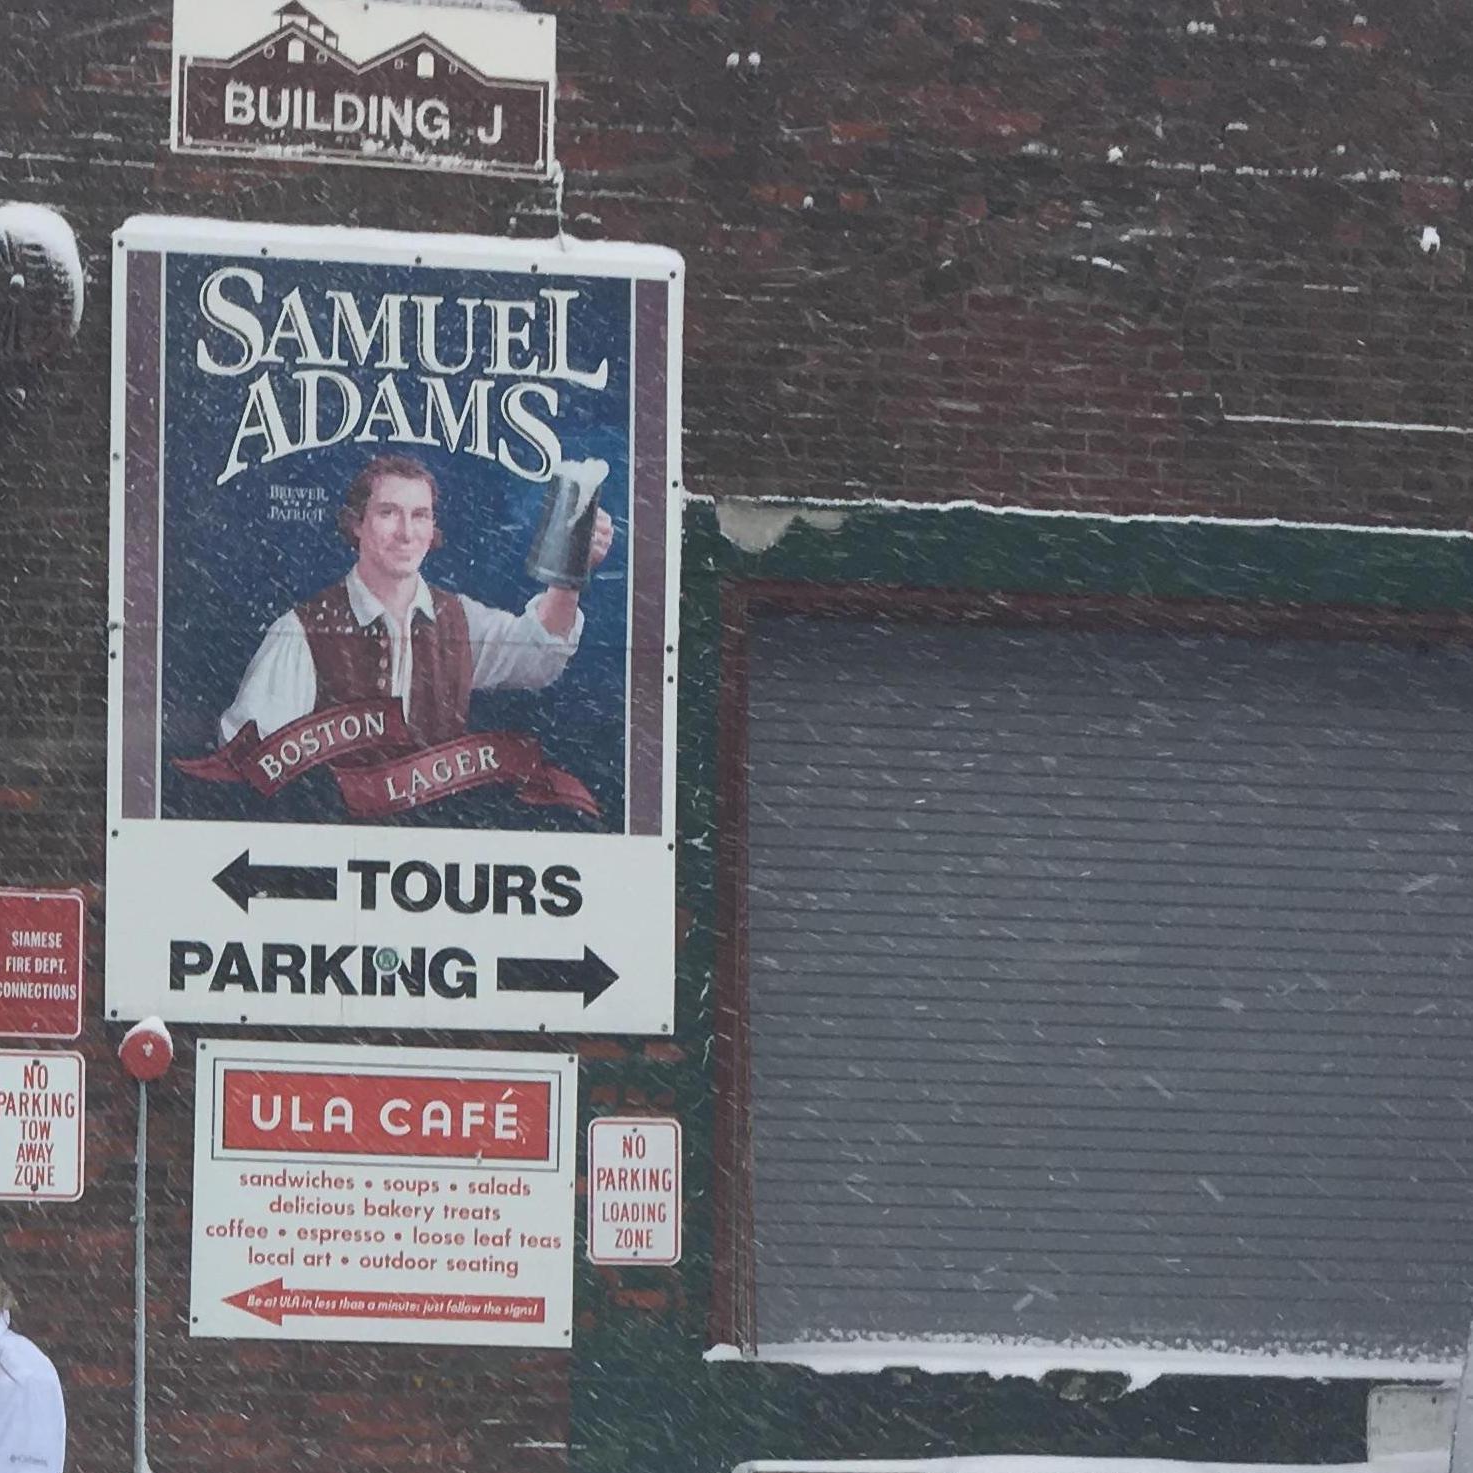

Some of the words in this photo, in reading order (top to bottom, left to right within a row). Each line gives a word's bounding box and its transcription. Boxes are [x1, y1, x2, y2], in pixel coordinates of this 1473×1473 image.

[225, 82, 450, 141] BUILDING
[477, 104, 503, 145] J
[196, 266, 609, 390] SAMUEL
[216, 370, 562, 486] ADAMS
[270, 485, 328, 501] BREWER
[257, 711, 386, 782] BOSTON
[384, 745, 501, 802] LAGER
[348, 860, 583, 918] TOURS
[11, 931, 63, 948] SIAMESE
[5, 956, 32, 973] FIRE
[34, 957, 67, 975] DEPT.
[169, 940, 477, 1000] PARKING
[23, 1065, 48, 1090] NO
[251, 1094, 354, 1134] ULA
[379, 1087, 518, 1141] CAFÉ
[20, 1120, 51, 1141] TOW
[16, 1143, 54, 1164] AWAY
[622, 1134, 646, 1159] NO
[14, 1165, 55, 1187] ZONE
[239, 1169, 355, 1190] sandwiches
[383, 1178, 440, 1197] soups
[468, 1176, 531, 1197] salads
[596, 1167, 672, 1192] PARKING
[269, 1194, 355, 1216] delicious
[364, 1198, 435, 1223] bakery
[444, 1204, 501, 1221] treats
[602, 1202, 667, 1223] LOADING
[205, 1218, 268, 1238] coffee
[297, 1227, 385, 1245] espresso
[413, 1226, 465, 1245] loose
[474, 1227, 512, 1247] leaf
[520, 1232, 562, 1249] teas
[615, 1228, 653, 1249] ZONE
[248, 1246, 295, 1266] local
[303, 1252, 331, 1267] art
[359, 1250, 438, 1270] outdoor
[446, 1254, 519, 1279] seating
[264, 1296, 277, 1308] at
[302, 1296, 312, 1308] in
[314, 1295, 336, 1309] less
[339, 1296, 365, 1310] than
[367, 1301, 376, 1311] a
[423, 1300, 443, 1315] just
[447, 1299, 481, 1314] follow
[484, 1301, 501, 1315] the
